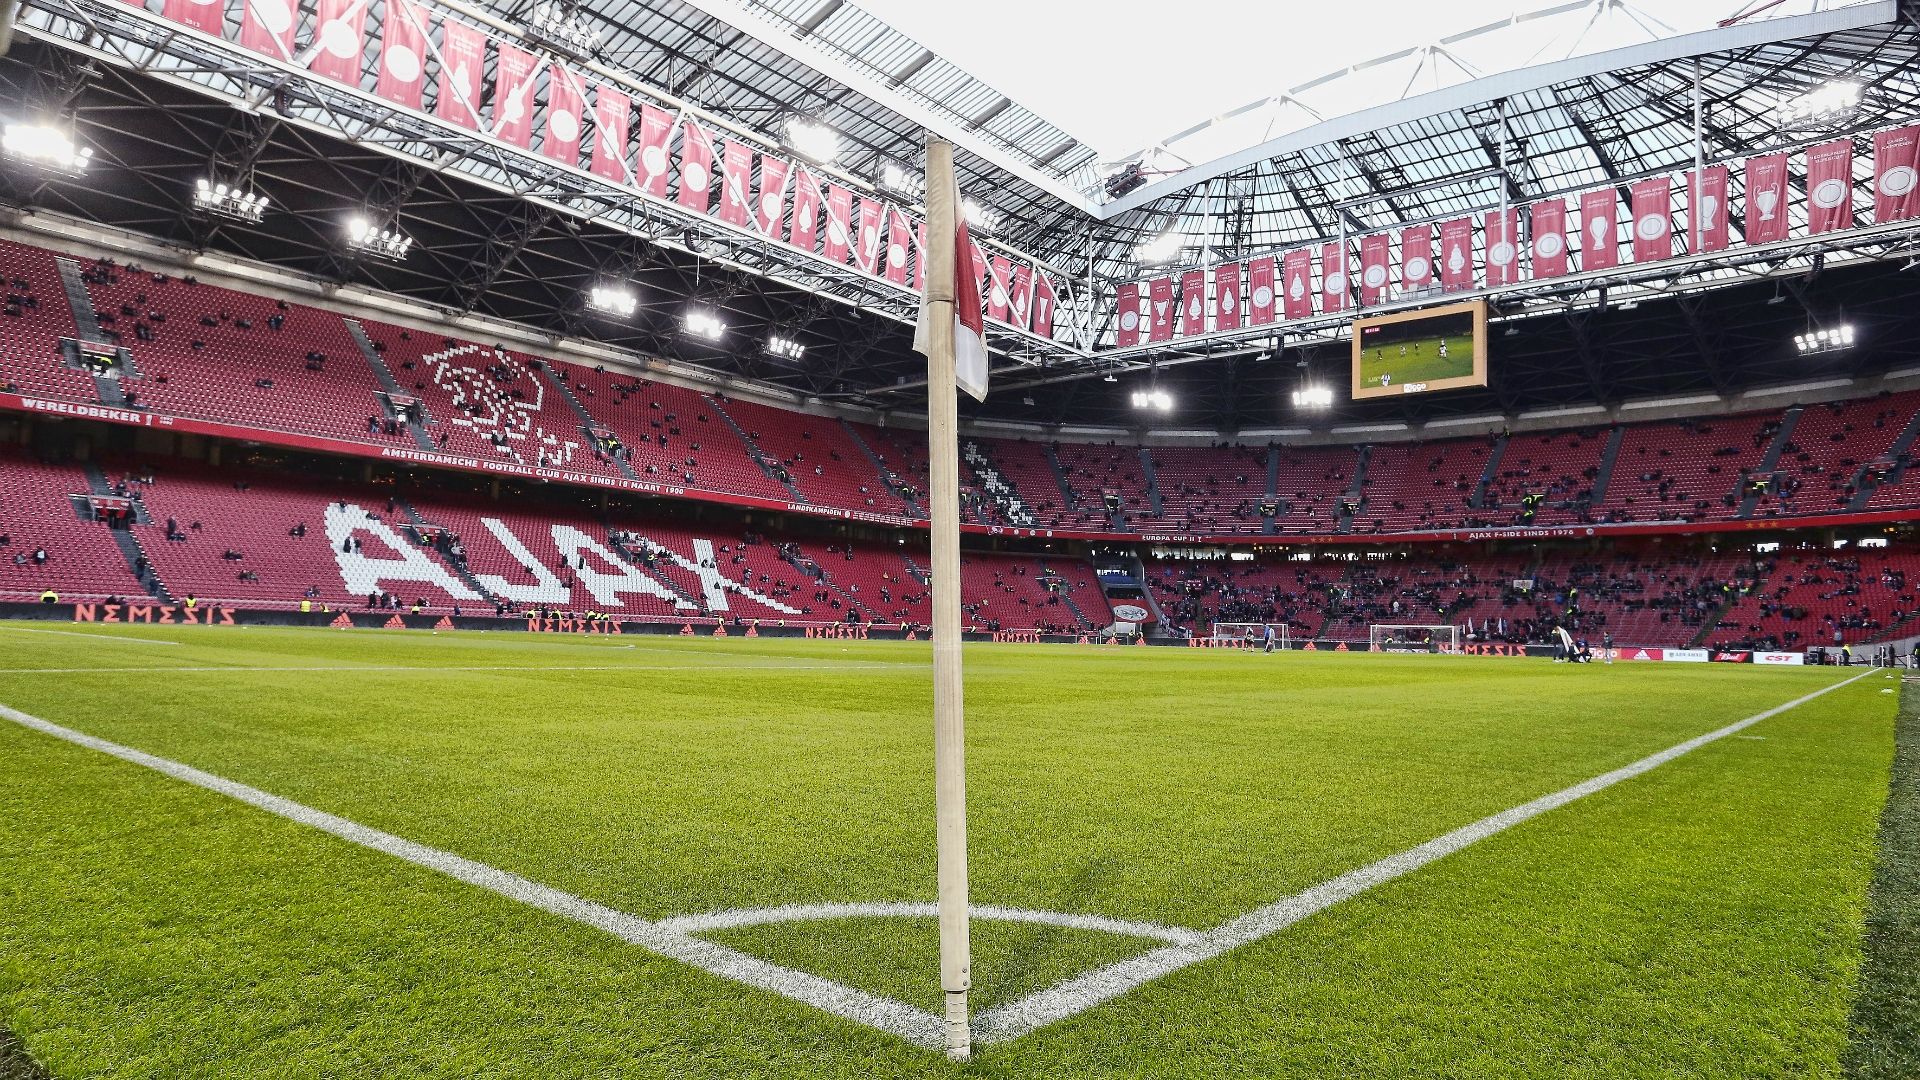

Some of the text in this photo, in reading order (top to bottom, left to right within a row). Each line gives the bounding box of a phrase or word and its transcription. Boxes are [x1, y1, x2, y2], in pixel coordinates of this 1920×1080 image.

[21, 397, 141, 423] WERELDBEKER
[382, 447, 684, 495] AMSTERDAMSCHE FOOTBALL CLUB AJAX SINDS 18 MAART 1900
[787, 503, 842, 516] LANDSKAMPIOEN
[1469, 531, 1492, 539] AJAX
[1523, 529, 1549, 537] SINDS
[324, 501, 803, 615] AJAX
[75, 603, 235, 625] NEMESIS
[528, 618, 622, 634] NEMESIS
[805, 627, 869, 640] NEMESIS
[992, 632, 1042, 643] NEMESIS
